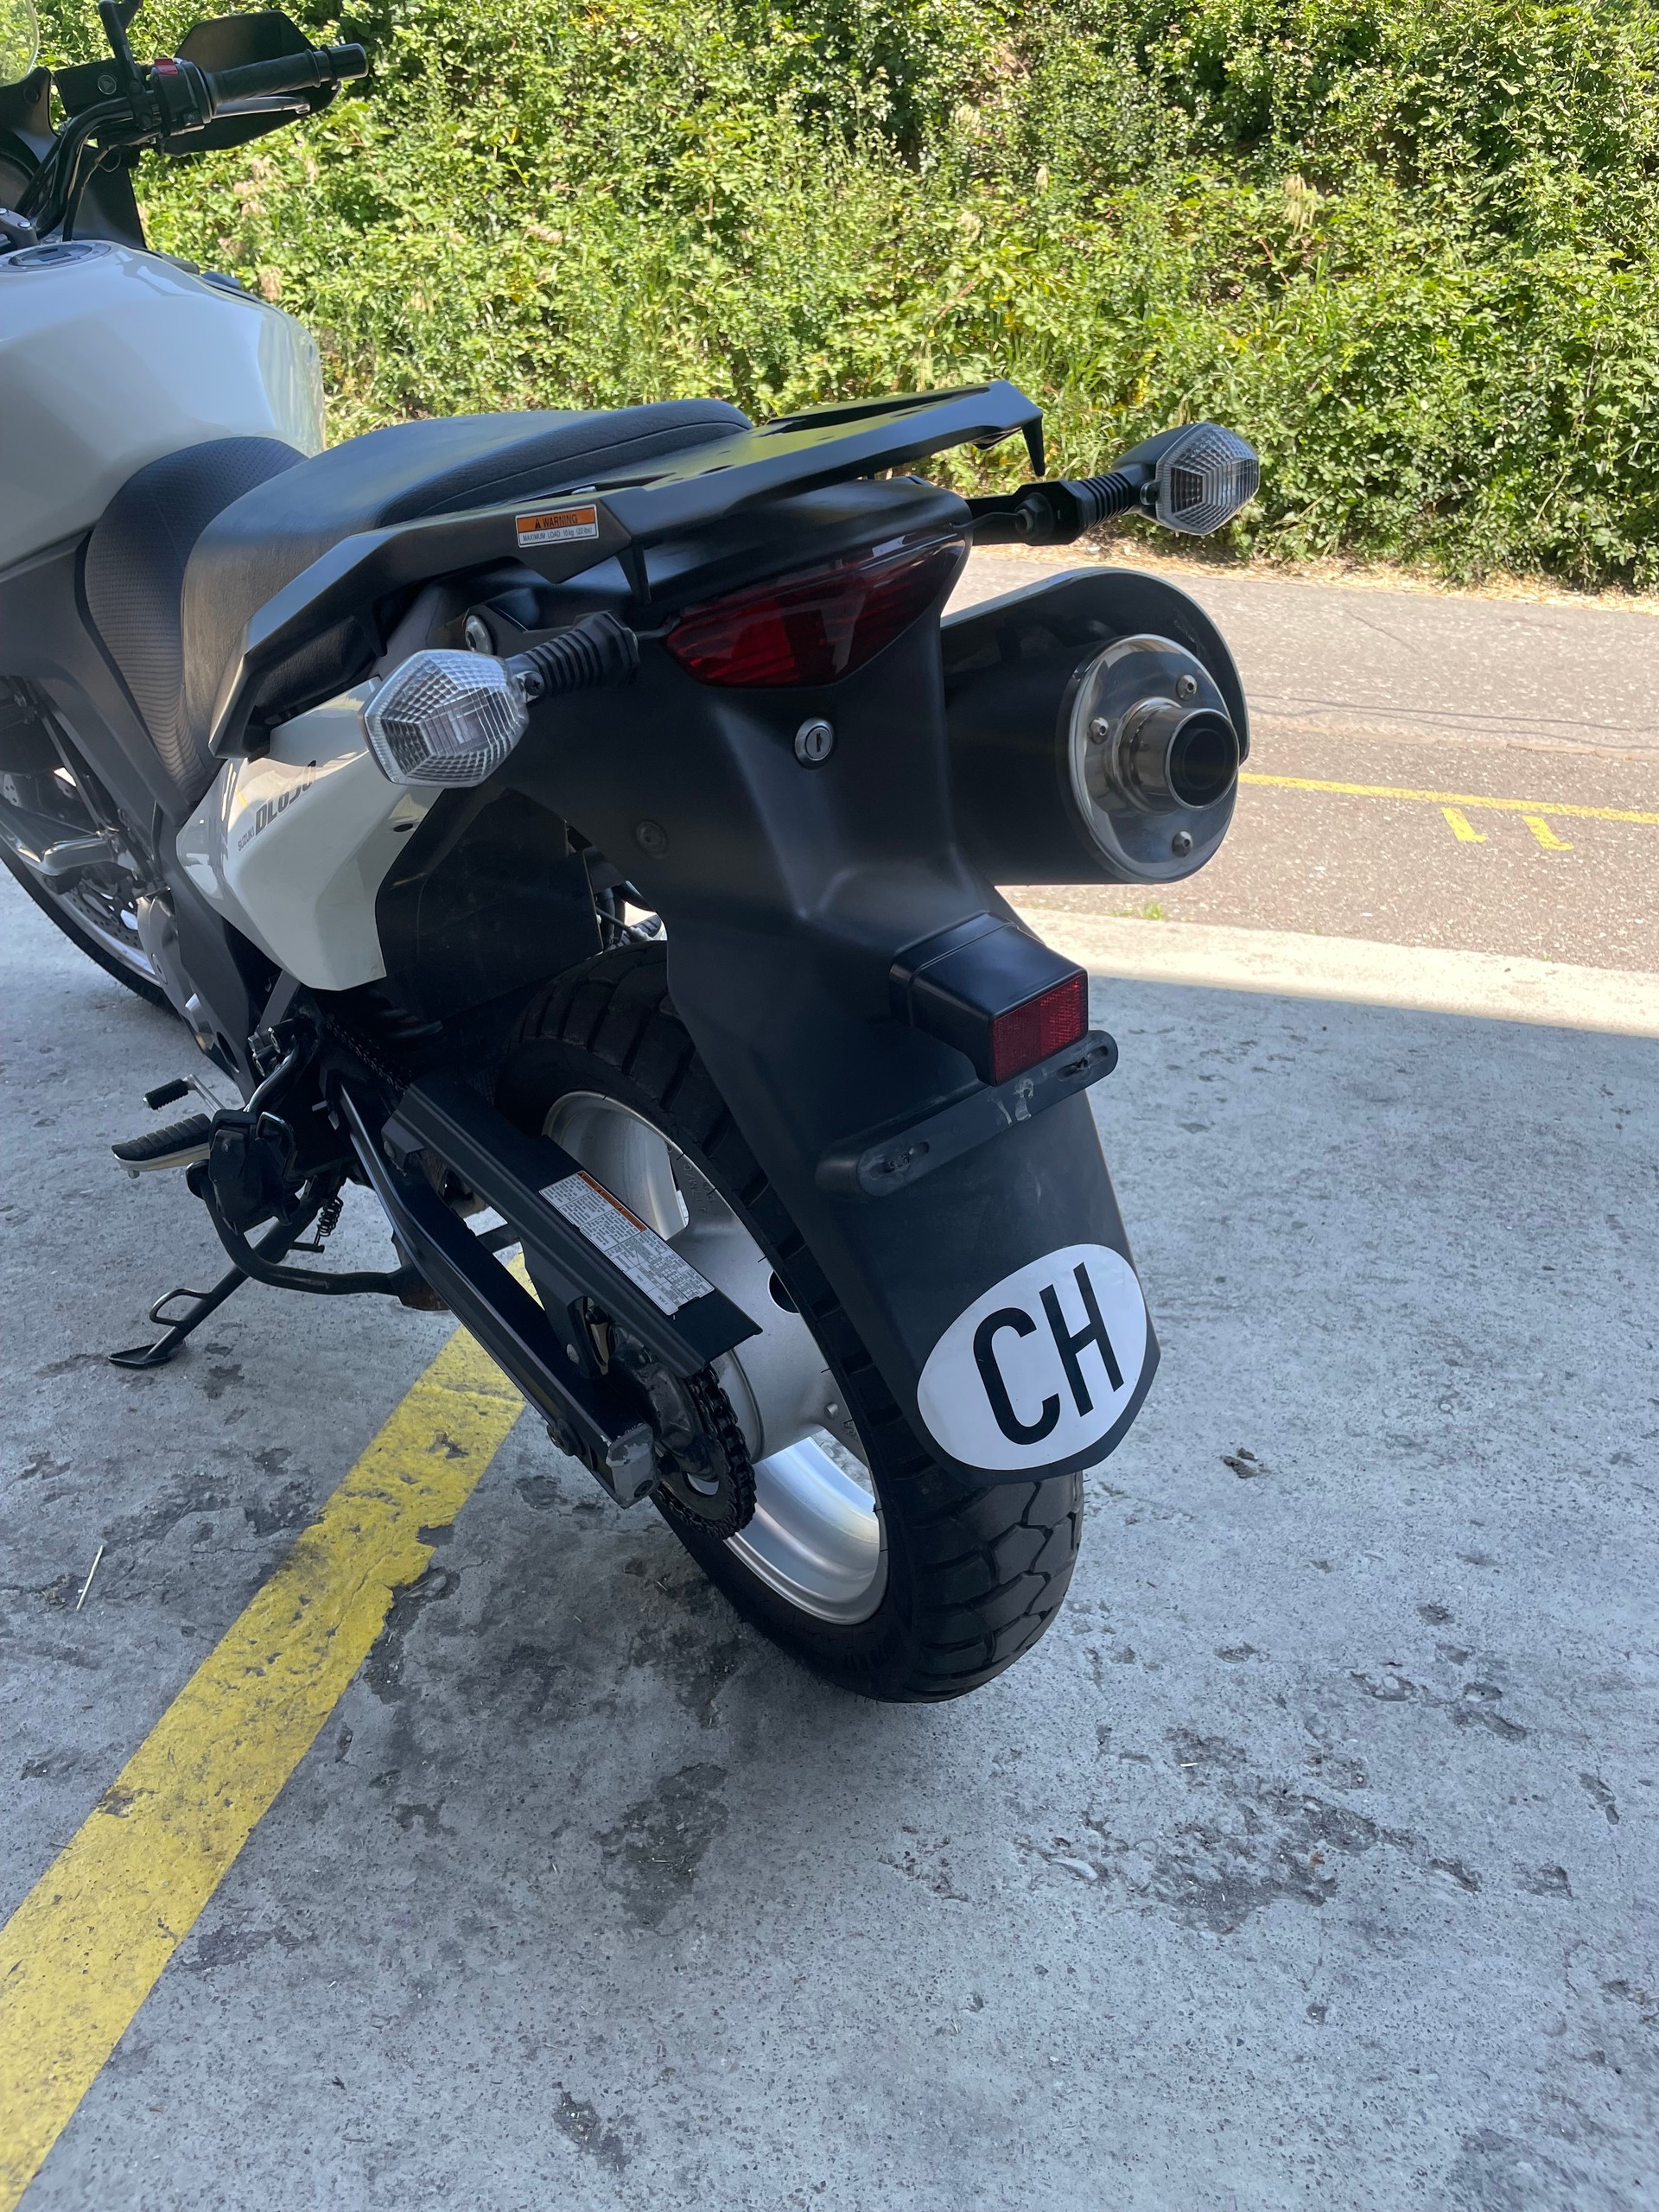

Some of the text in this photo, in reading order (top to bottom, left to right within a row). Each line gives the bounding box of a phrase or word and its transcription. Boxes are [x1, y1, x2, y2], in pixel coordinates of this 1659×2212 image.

[543, 514, 578, 528] WARNING
[522, 532, 546, 541] MAXIMUM
[238, 827, 255, 852] SUZUKI
[973, 1262, 1124, 1446] CH
